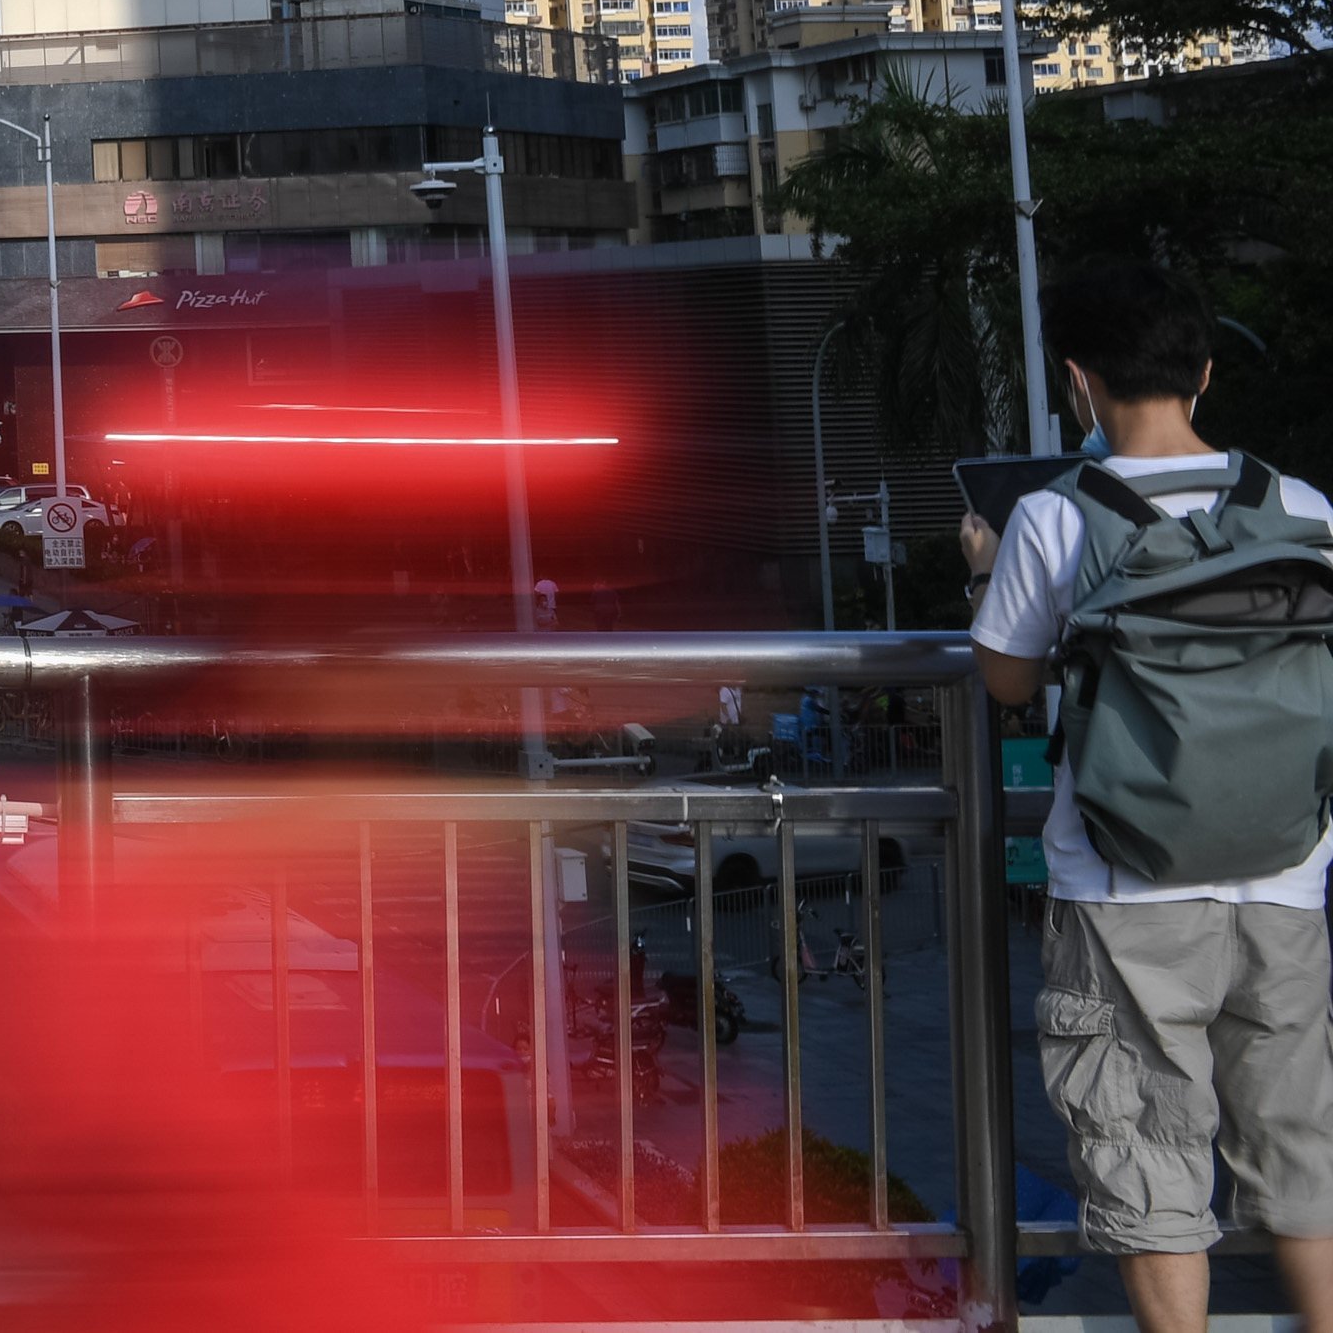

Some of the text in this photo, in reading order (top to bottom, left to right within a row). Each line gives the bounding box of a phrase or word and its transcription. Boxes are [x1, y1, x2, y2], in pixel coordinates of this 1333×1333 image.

[172, 186, 268, 213] 南京证券
[176, 289, 268, 309] Pizza Hut
